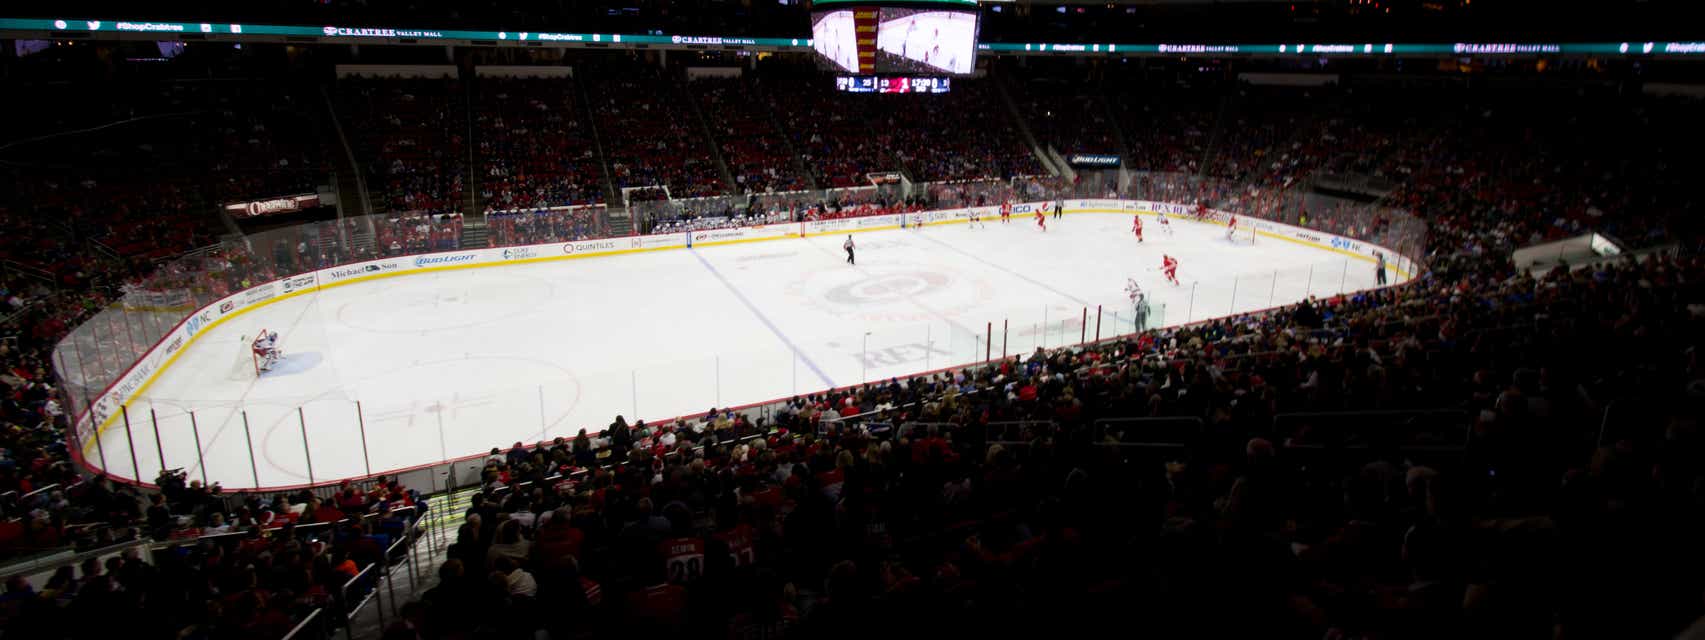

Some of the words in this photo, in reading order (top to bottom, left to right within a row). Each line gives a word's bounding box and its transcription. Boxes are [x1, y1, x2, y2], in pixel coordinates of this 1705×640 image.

[116, 22, 184, 32] #ShopCrabtree
[338, 28, 395, 37] CRABTREE
[998, 204, 1031, 215] GICO
[575, 242, 615, 252] QUINTILES
[444, 254, 477, 264] LIGHT
[330, 266, 366, 280] Michael
